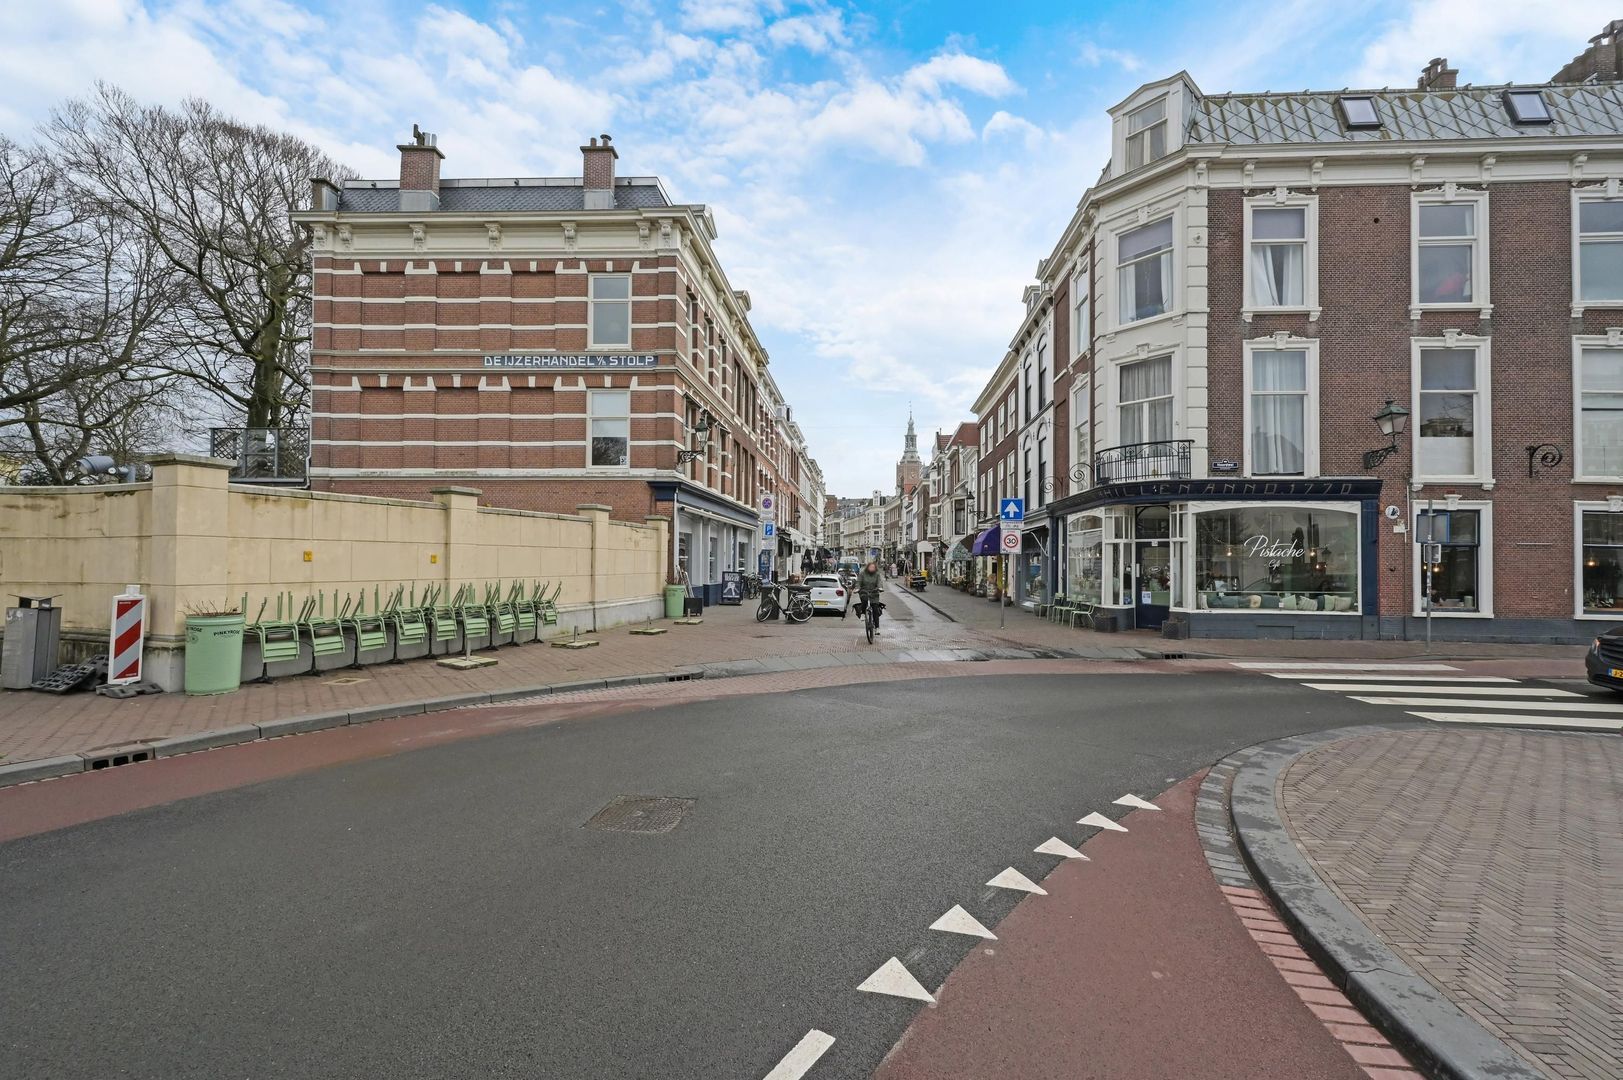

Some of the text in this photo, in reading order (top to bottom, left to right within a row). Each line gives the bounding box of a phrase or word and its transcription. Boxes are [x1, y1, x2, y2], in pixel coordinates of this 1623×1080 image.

[484, 356, 501, 365] DE
[504, 356, 595, 366] IJZERHANDEL
[609, 356, 654, 366] STOLP
[1289, 483, 1353, 495] 1770
[1244, 534, 1305, 558] Pistache
